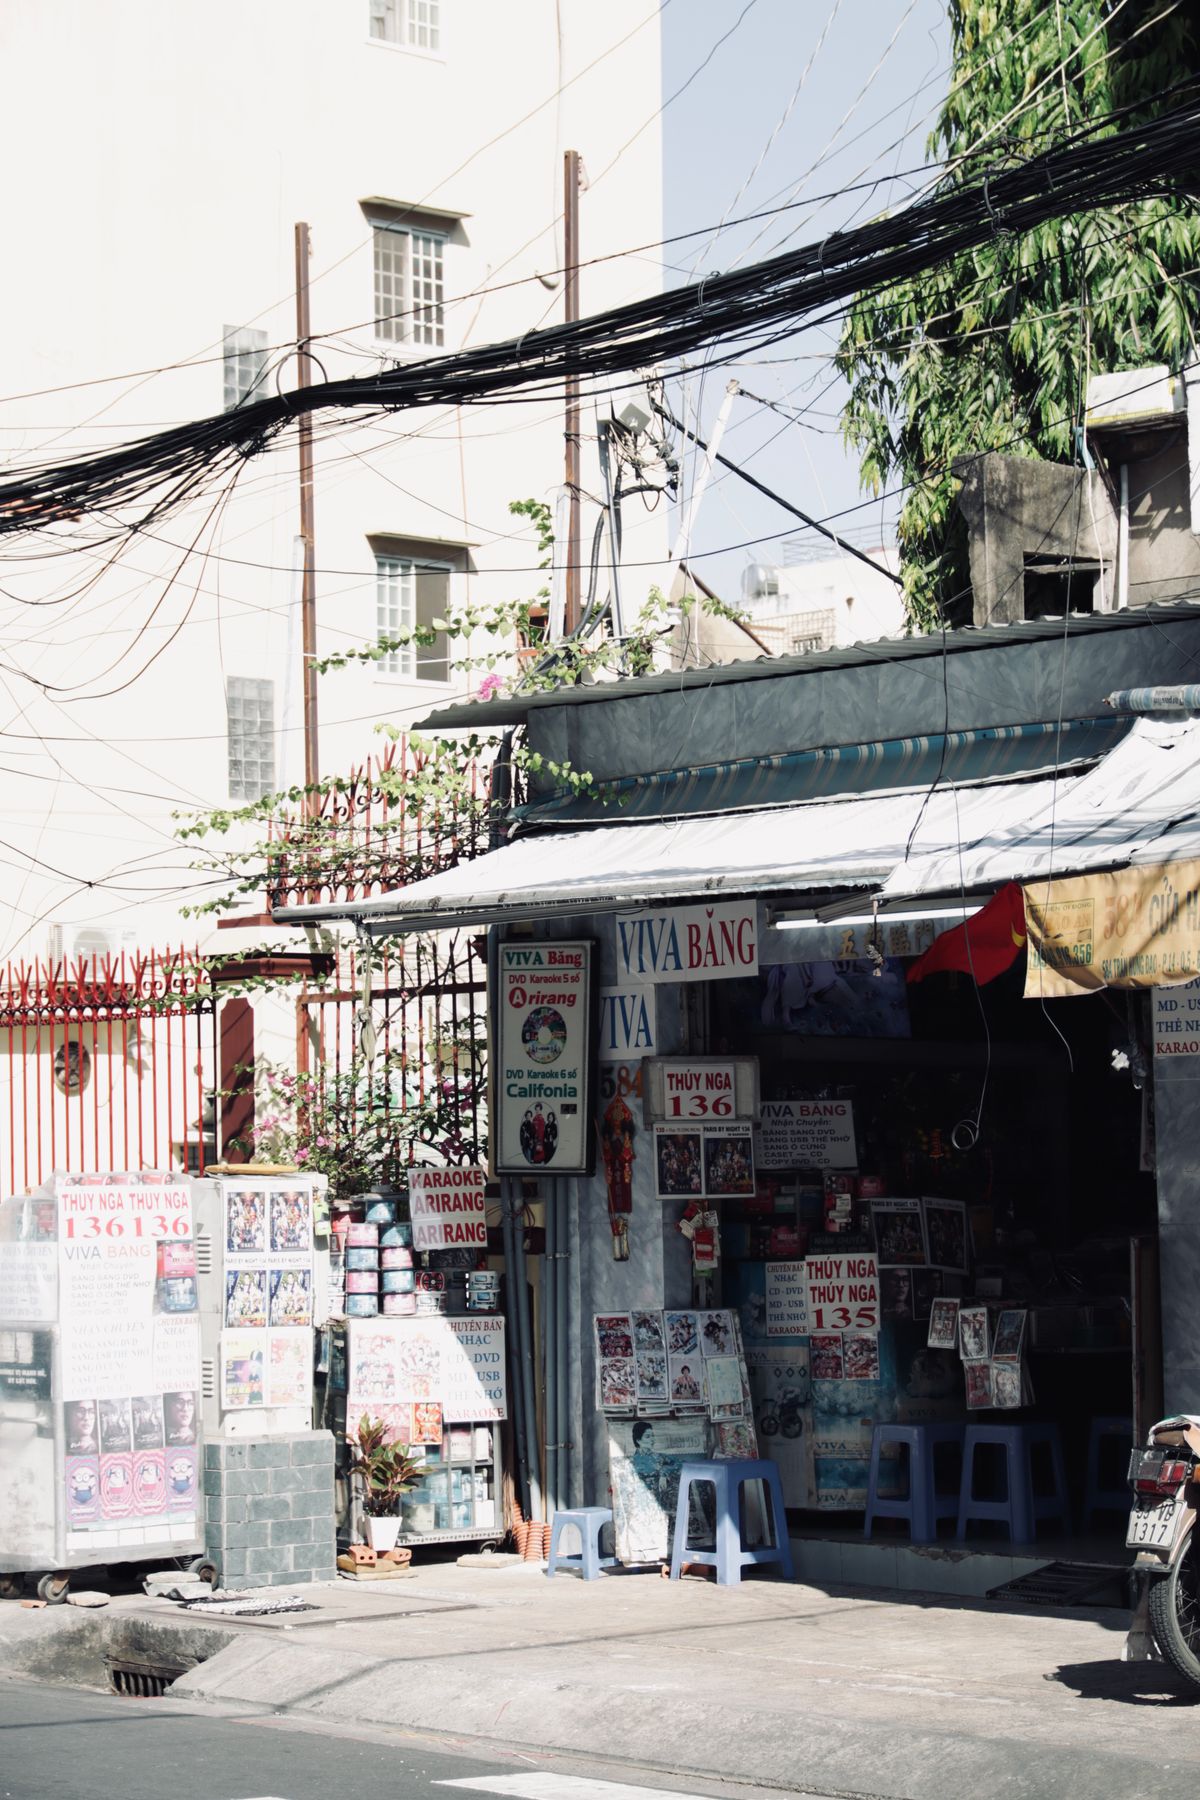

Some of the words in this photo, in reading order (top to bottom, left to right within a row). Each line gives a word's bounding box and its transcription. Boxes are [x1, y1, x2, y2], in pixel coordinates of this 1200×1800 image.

[618, 917, 683, 974] VIVA
[687, 907, 756, 969] BĂNG
[505, 951, 543, 965] VIVA
[548, 950, 582, 968] Băng
[509, 974, 526, 984] DVD
[530, 973, 562, 983] Karaoke
[563, 973, 569, 983] 5
[570, 971, 581, 983] số
[509, 986, 577, 1009] Arirang
[1158, 1000, 1178, 1011] MD
[506, 1069, 524, 1079] DVD
[527, 1069, 559, 1079] Karaoke
[560, 1069, 566, 1079] 6
[568, 1067, 577, 1079] số
[667, 1068, 702, 1091] THÚY
[705, 1072, 732, 1090] NGA
[506, 1083, 577, 1098] Califonia
[668, 1094, 732, 1117] 136
[411, 1170, 483, 1189] KARAOKE
[99, 1192, 124, 1211] NGA
[164, 1191, 189, 1210] NGA
[414, 1192, 484, 1215] ARIRANG
[65, 1215, 125, 1239] 136
[134, 1214, 190, 1238] 136
[416, 1221, 486, 1246] ARIRANG
[64, 1245, 102, 1261] VIVA
[807, 1256, 842, 1280] THÚY
[847, 1259, 877, 1278] NGA
[769, 1287, 781, 1295] CD
[786, 1286, 804, 1295] DVD
[810, 1281, 845, 1304] THÚY
[849, 1284, 877, 1302] NGA
[769, 1300, 782, 1308] MD
[788, 1299, 804, 1308] USB
[812, 1307, 877, 1330] 135
[768, 1326, 808, 1335] KARAOKE
[474, 1352, 500, 1363] DVD
[477, 1371, 500, 1382] USB
[447, 1407, 505, 1419] KARAOKE
[815, 1442, 847, 1450] VIVA
[1132, 1522, 1168, 1543] 1317
